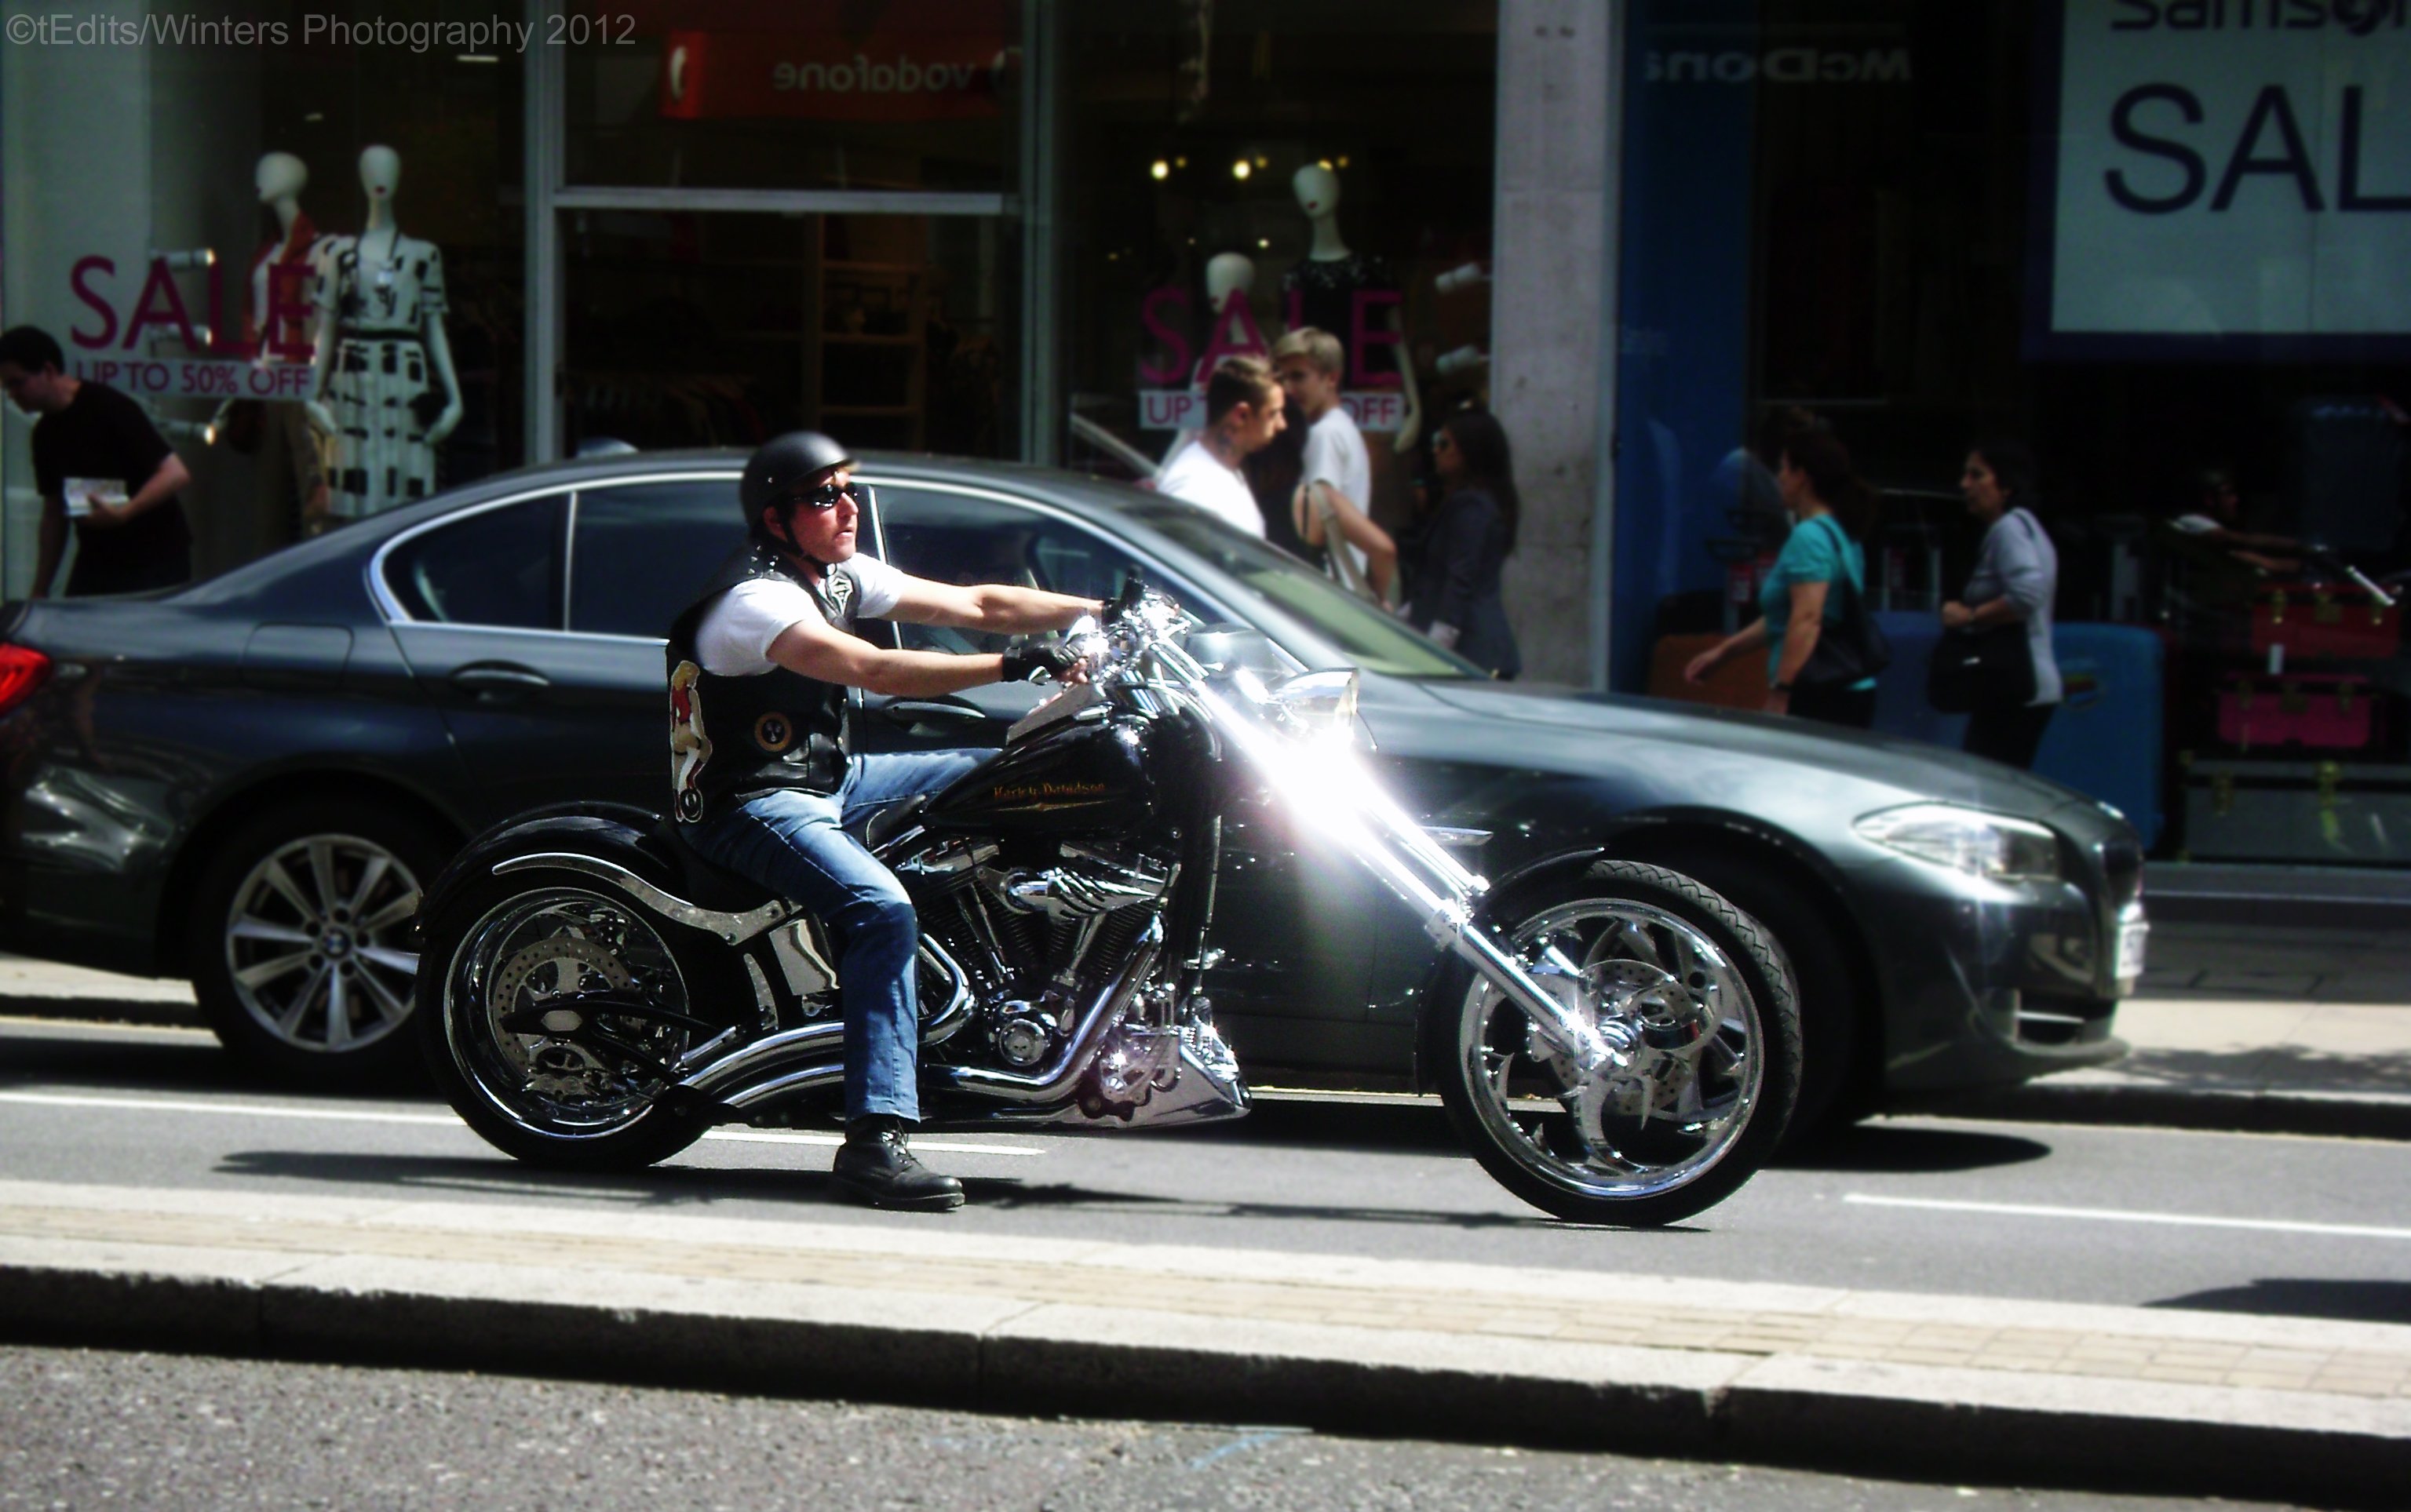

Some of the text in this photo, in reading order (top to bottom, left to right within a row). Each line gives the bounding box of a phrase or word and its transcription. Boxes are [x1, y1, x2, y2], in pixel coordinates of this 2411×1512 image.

[71, 255, 316, 357] SALE
[123, 362, 170, 392] TO
[181, 363, 238, 394] 50%
[249, 366, 311, 395] OFF
[1147, 396, 1193, 424] UP
